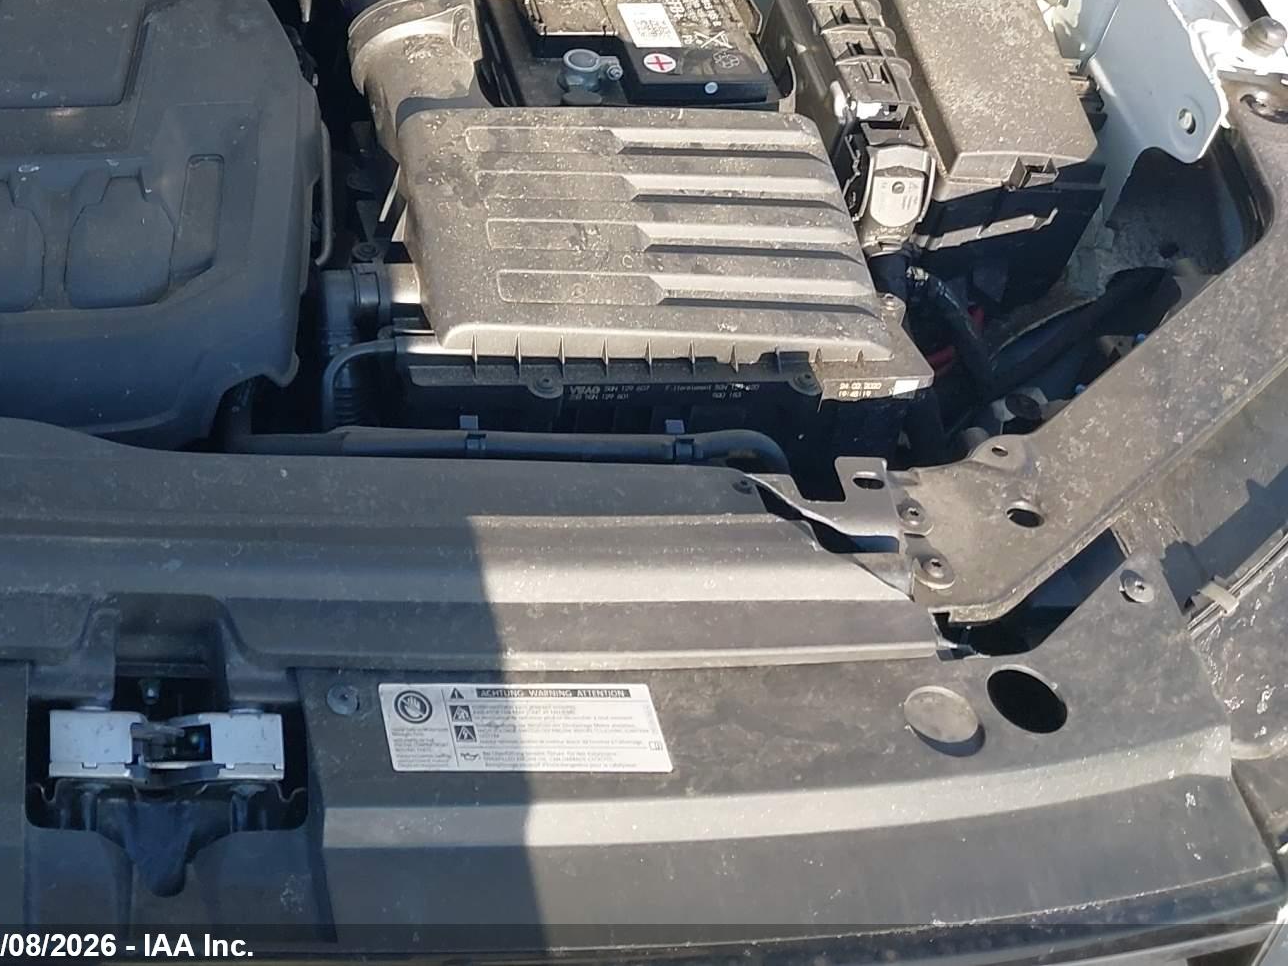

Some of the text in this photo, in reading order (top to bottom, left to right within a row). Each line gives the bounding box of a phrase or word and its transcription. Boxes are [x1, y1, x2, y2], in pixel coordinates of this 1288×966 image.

[480, 689, 625, 698] ACHTUNG WARNING ATTENTION
